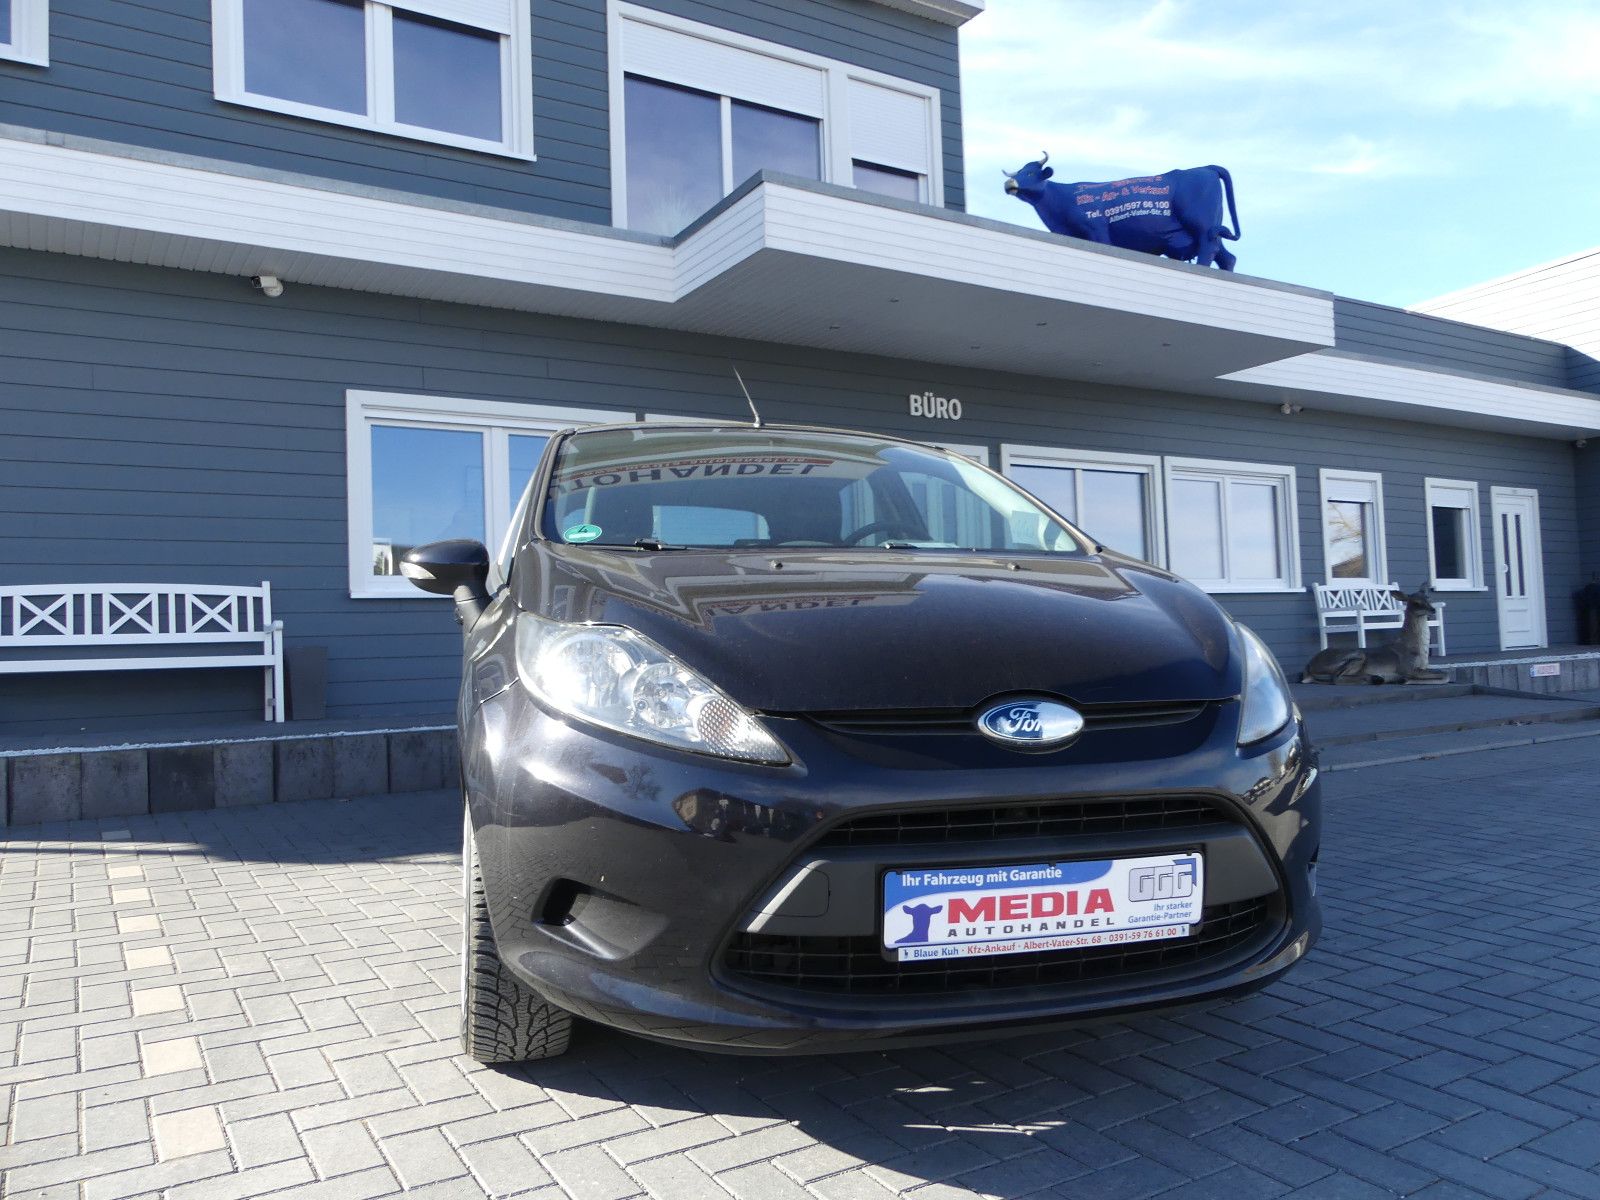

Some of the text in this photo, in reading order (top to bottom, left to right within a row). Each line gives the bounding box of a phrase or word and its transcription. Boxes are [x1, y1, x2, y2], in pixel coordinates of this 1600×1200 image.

[1086, 210, 1103, 219] Tel.
[1155, 201, 1170, 209] 100
[909, 391, 962, 421] BÜRO
[902, 866, 1063, 887] Ihr Fahrzeug mit Garantie
[947, 888, 1115, 924] MEDIA
[1153, 901, 1193, 911] Ihr starker
[947, 917, 1115, 938] AUTOHANDEL
[1127, 911, 1192, 923] Garantie-Partner
[913, 949, 939, 958] Blaue
[941, 947, 959, 957] Kuh
[967, 943, 1016, 955] Kfz-Ankauf
[1023, 937, 1089, 950] Albert-Vater-Str.
[1091, 936, 1102, 944] 68
[1108, 931, 1141, 943] 0391-59
[1143, 930, 1153, 939] 76
[1155, 929, 1165, 938] 61
[1167, 927, 1177, 936] 00
